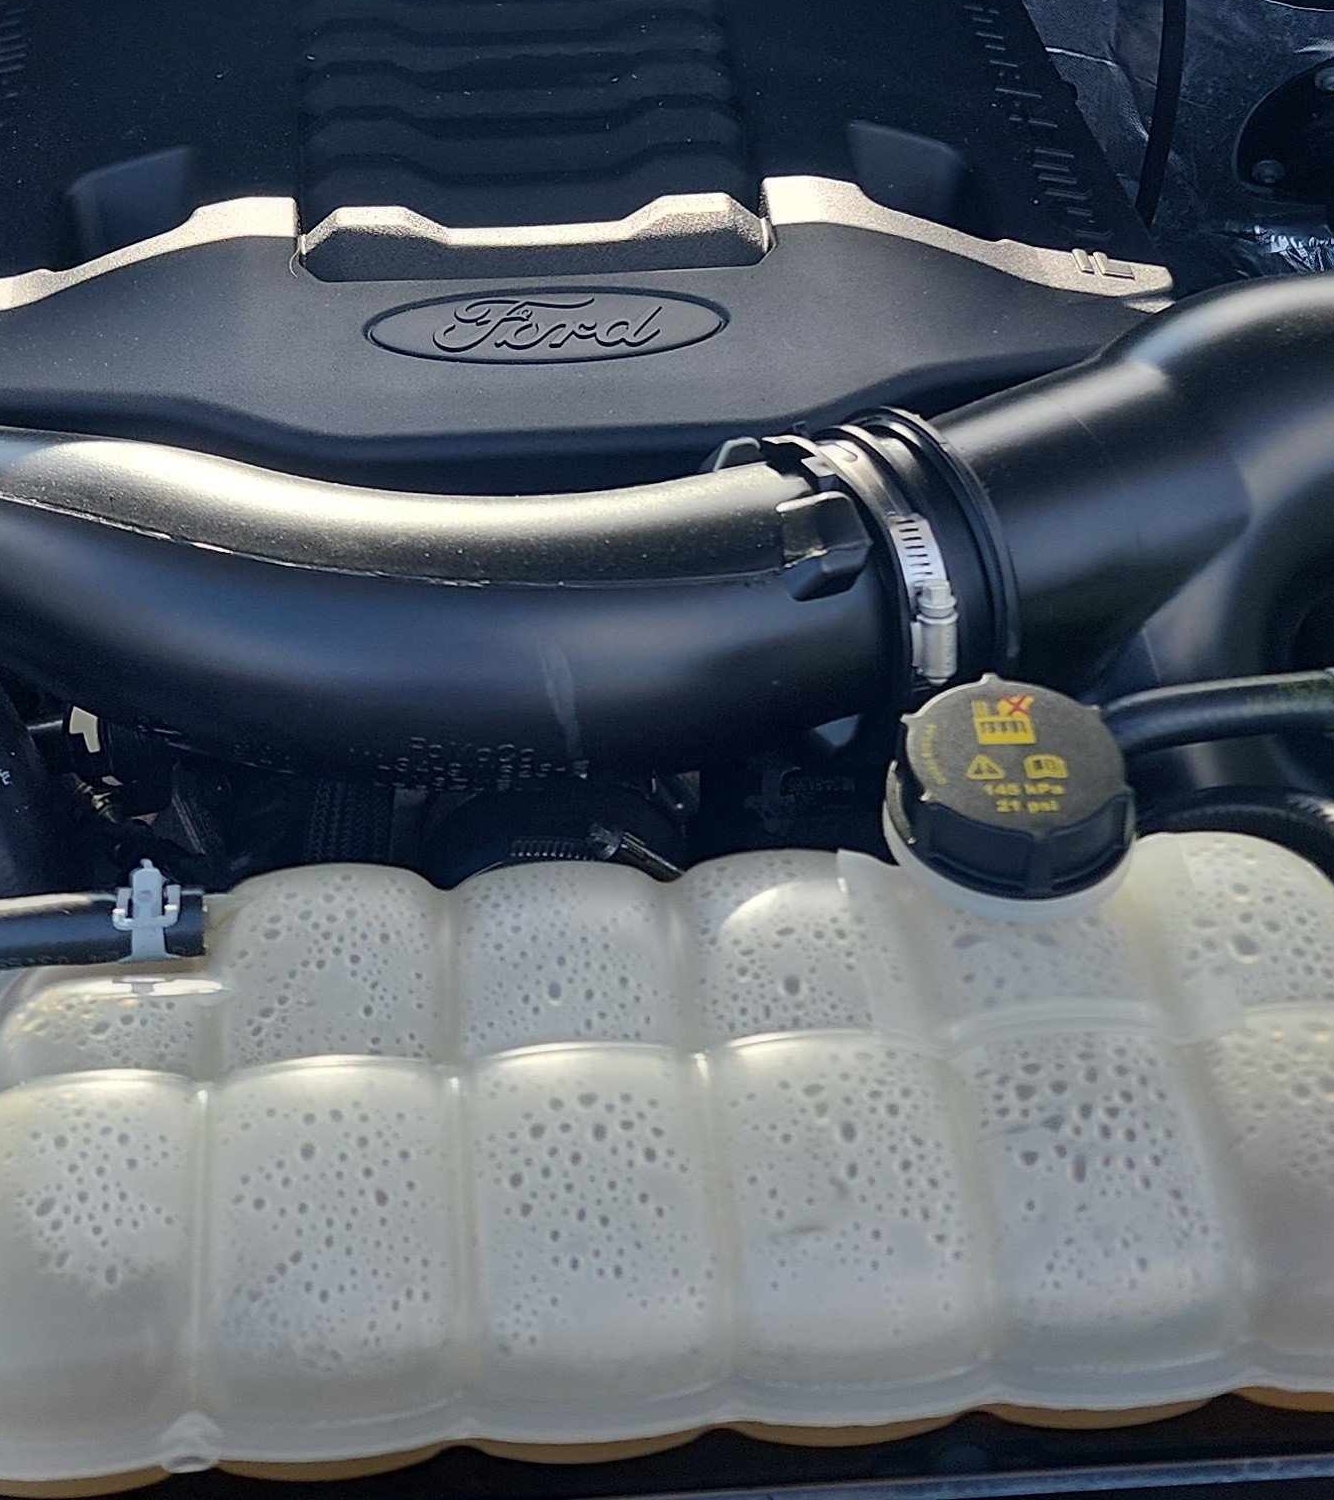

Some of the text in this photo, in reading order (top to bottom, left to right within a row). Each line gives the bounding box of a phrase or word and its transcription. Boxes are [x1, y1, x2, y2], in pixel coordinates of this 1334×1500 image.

[433, 297, 662, 352] Ford
[1023, 781, 1066, 797] kPa
[996, 798, 1060, 815] 21 psi
